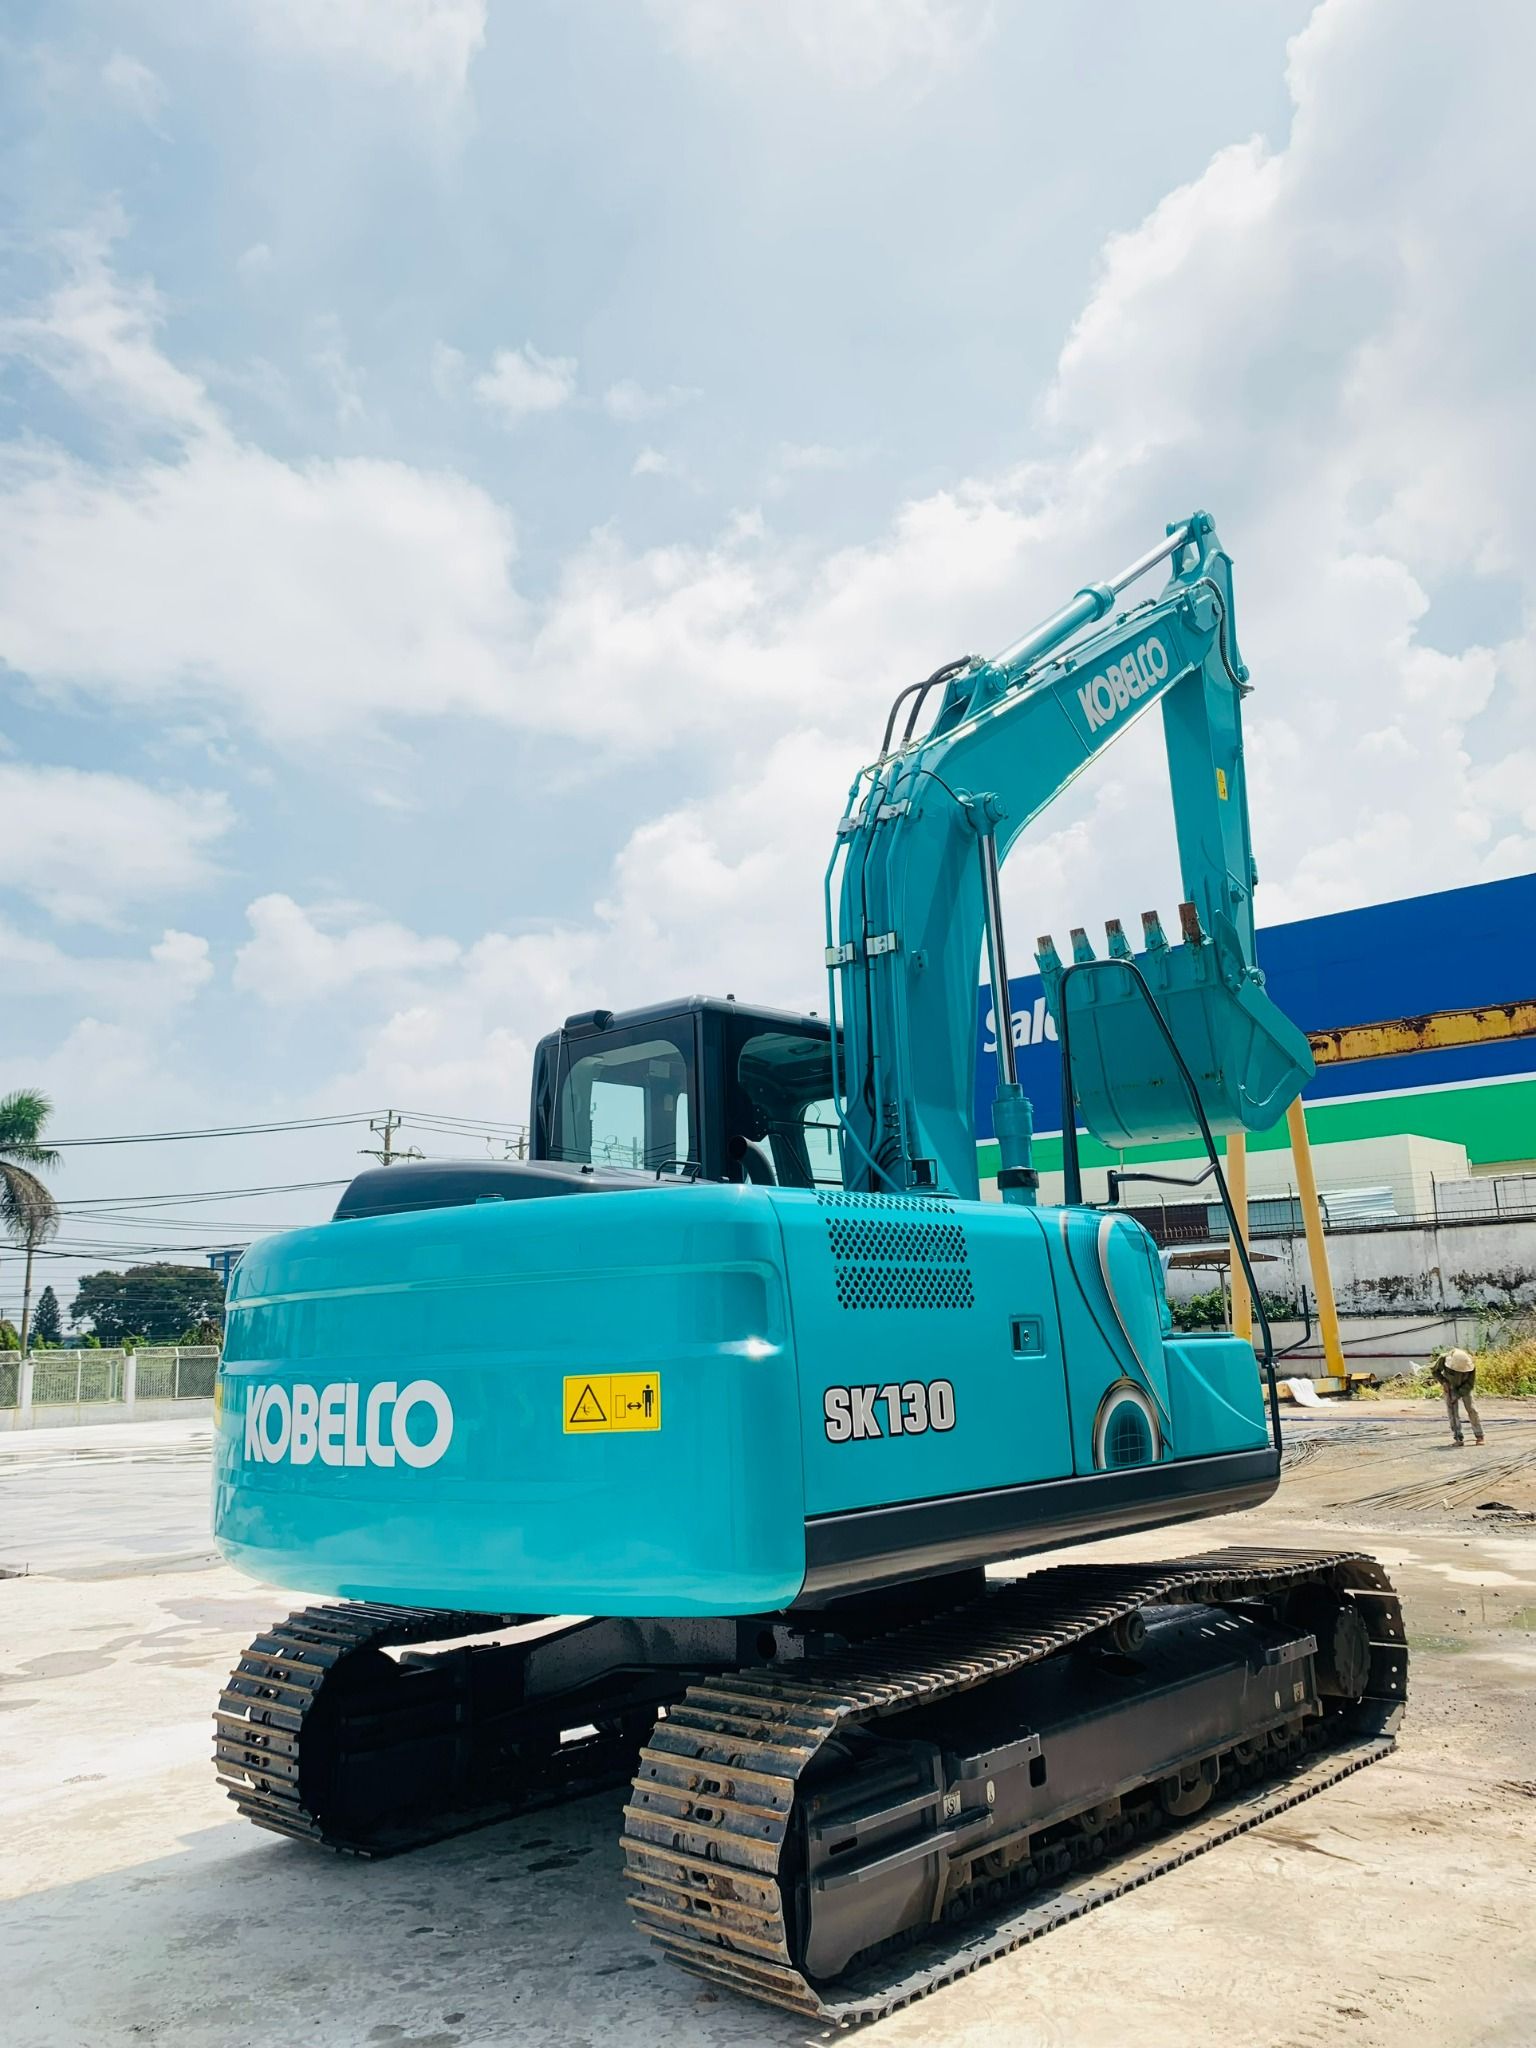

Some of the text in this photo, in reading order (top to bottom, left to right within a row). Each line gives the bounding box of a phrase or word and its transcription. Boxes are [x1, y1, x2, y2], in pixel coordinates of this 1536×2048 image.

[1077, 637, 1168, 733] KOBELCO
[244, 1379, 454, 1468] KOBELCO
[823, 1378, 957, 1443] SK130
